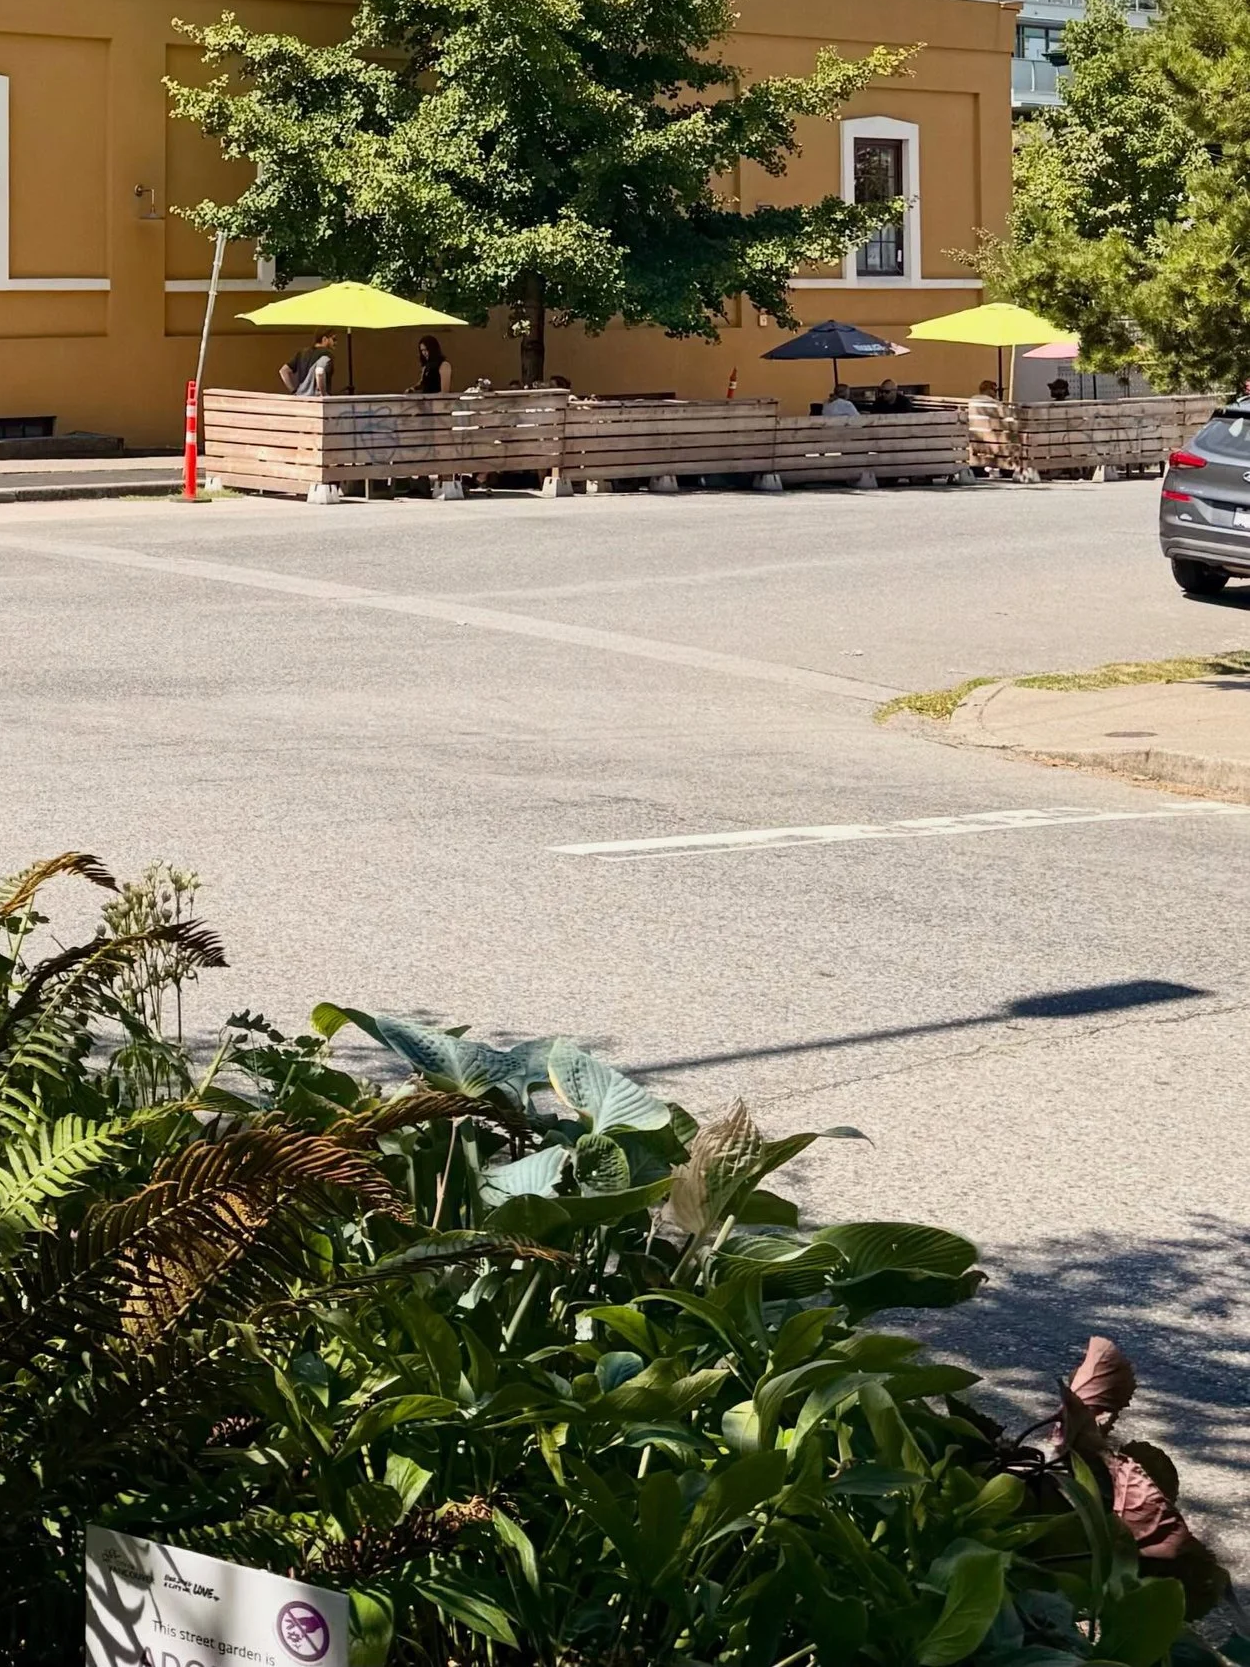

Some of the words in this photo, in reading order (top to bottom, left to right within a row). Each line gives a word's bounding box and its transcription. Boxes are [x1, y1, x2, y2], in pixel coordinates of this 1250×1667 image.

[152, 1619, 177, 1638] This
[179, 1629, 216, 1650] street
[217, 1640, 261, 1662] garden
[265, 1654, 276, 1666] is
